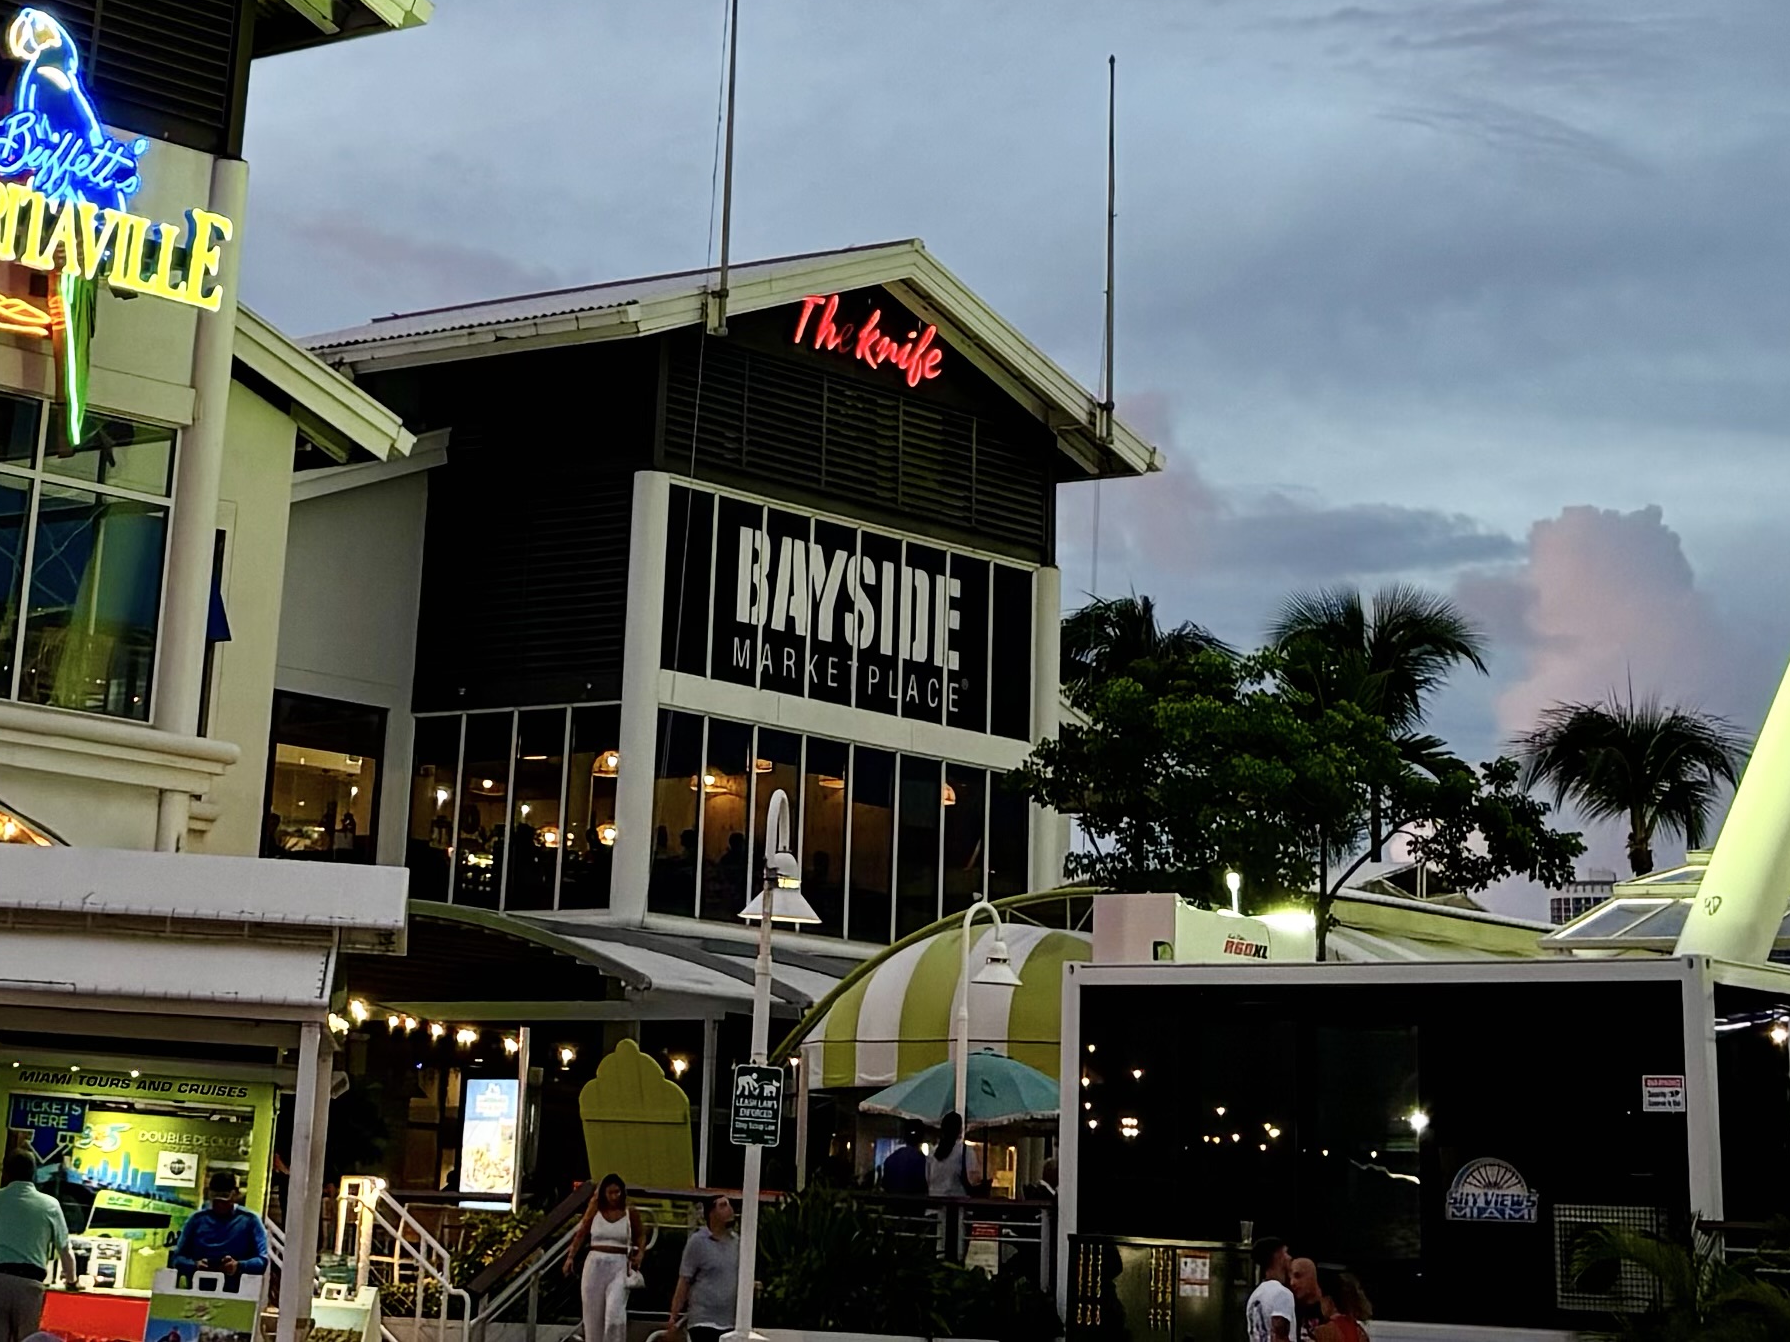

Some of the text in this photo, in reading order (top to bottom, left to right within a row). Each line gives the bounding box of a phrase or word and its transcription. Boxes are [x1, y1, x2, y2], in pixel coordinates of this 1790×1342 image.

[795, 294, 943, 388] The knife
[736, 526, 961, 671] BAYSIDE
[18, 1070, 248, 1098] MIAMI TOURS AND CRUISES
[19, 1097, 82, 1115] TICKETS
[27, 1113, 69, 1129] HERE
[138, 1128, 192, 1145] DOUBLE
[1451, 1207, 1536, 1220] MIAMI
